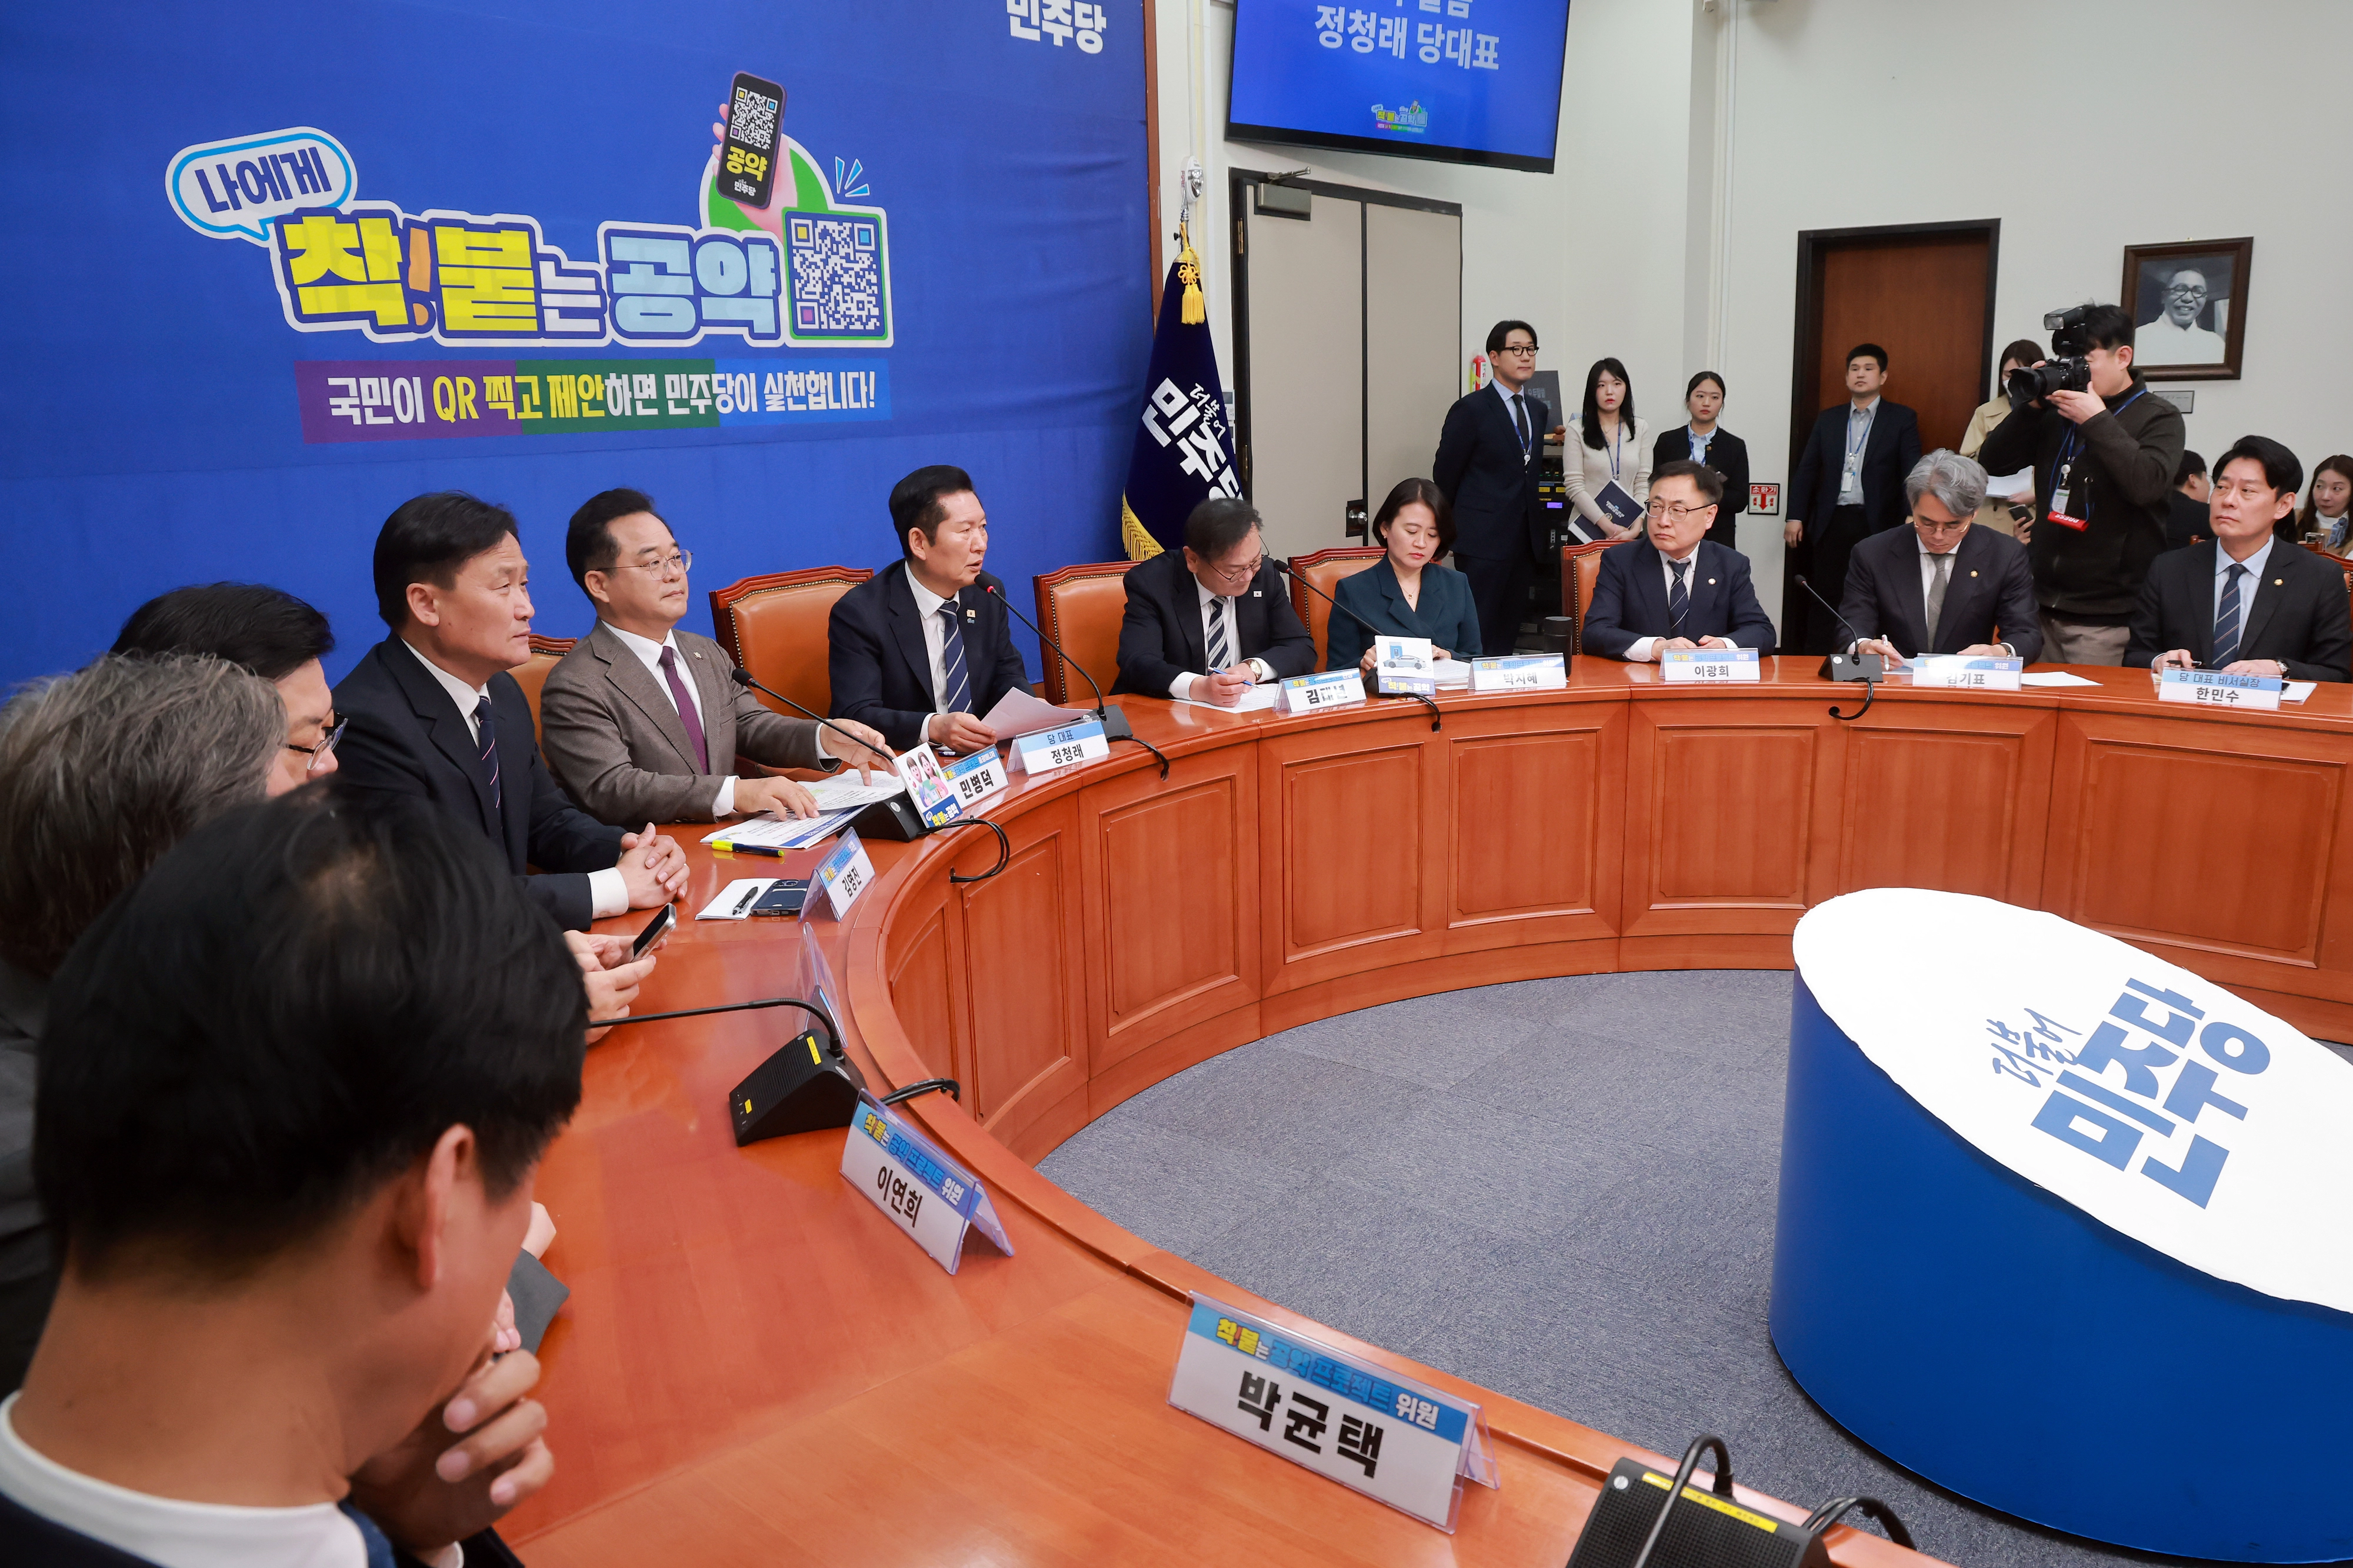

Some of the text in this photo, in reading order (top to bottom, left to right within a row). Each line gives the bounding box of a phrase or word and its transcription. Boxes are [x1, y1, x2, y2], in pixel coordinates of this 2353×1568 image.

[1006, 0, 1106, 54] 민주당
[1315, 5, 1499, 70] 정청래 당대표
[194, 146, 332, 213] 나에게
[726, 146, 768, 182] 공약
[734, 181, 756, 196] 민주당
[609, 235, 778, 333] 공약
[327, 370, 875, 425] 국민이 QR 찍고 제안하면 민주당이 실천합니다!
[1413, 683, 1431, 692] 공약
[1504, 672, 1538, 685] 박지혜
[1695, 665, 1729, 677] 이광희
[1947, 673, 1985, 685] 김기표
[2179, 672, 2261, 688] 당 대표 비서실장
[2197, 687, 2239, 702] 한민수
[1047, 730, 1074, 745] 당 대표
[1051, 743, 1084, 764] 정청래
[959, 769, 994, 799] 민병덕
[945, 803, 960, 819] 공약
[842, 865, 862, 898] 김영진
[2031, 978, 2271, 1210] 민주당
[888, 1133, 911, 1163] 공약
[905, 1147, 945, 1190] 프로젝트
[941, 1177, 965, 1206] 위원
[877, 1166, 923, 1228] 이연희
[1269, 1339, 1311, 1378] 공약
[1310, 1357, 1392, 1412] 프로젝트
[1395, 1392, 1440, 1431] 위원
[1237, 1370, 1384, 1479] 박균택
